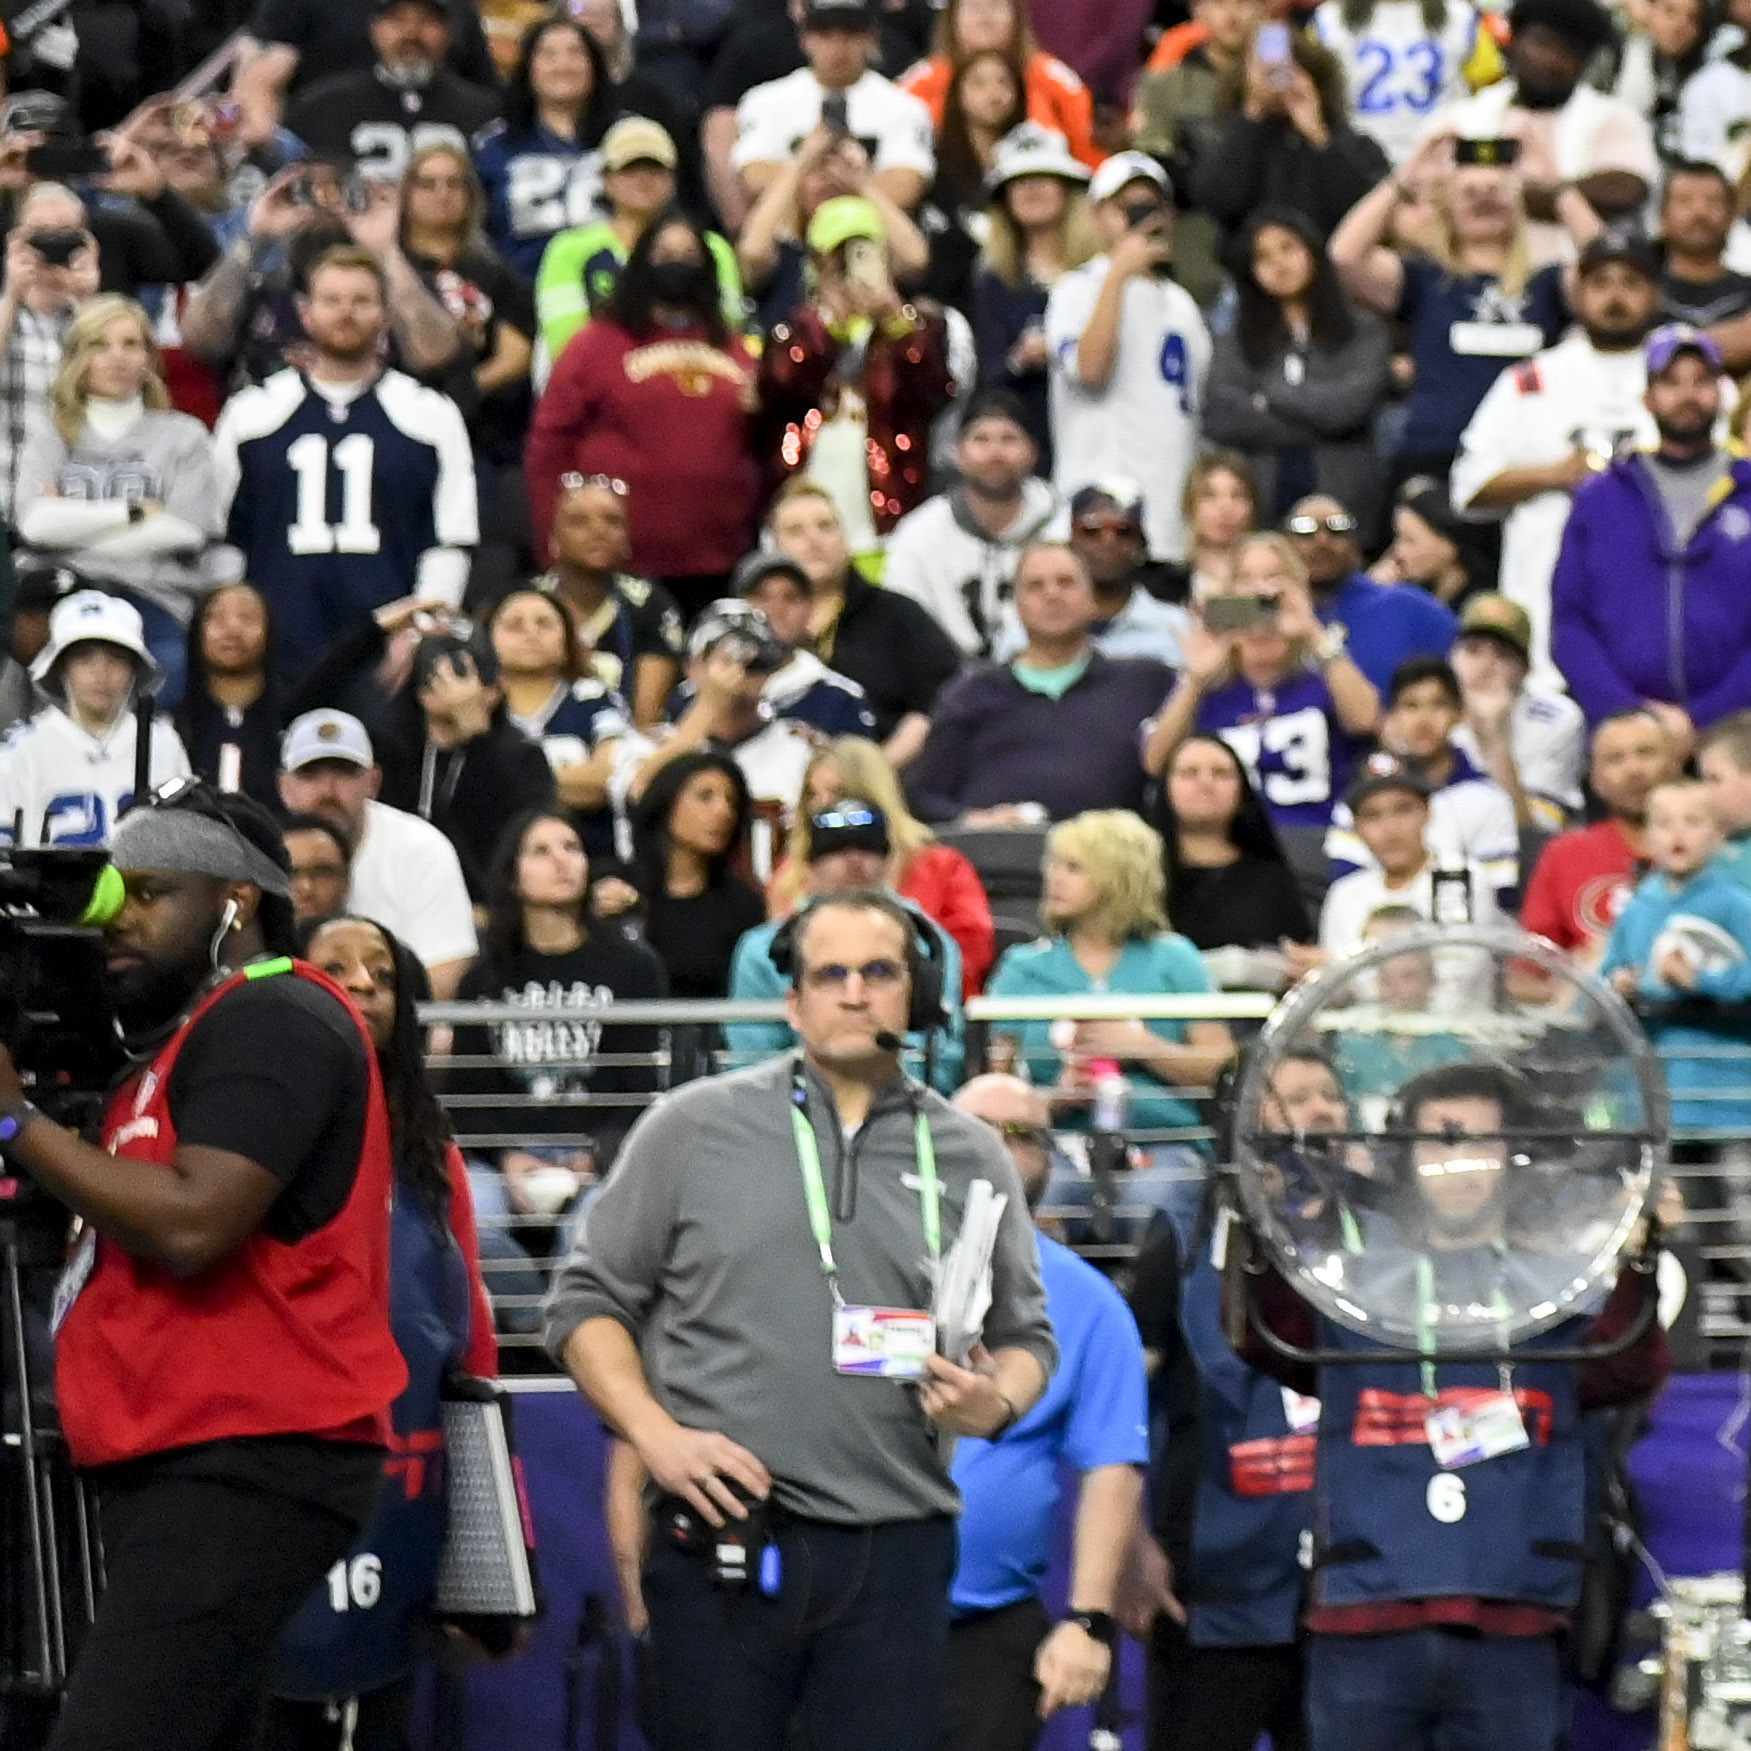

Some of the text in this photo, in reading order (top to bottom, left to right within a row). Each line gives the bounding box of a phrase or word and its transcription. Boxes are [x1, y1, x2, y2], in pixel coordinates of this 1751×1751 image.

[1355, 38, 1446, 115] 23
[287, 433, 380, 554] 11
[1426, 1472, 1467, 1523] 6
[326, 1552, 382, 1613] 16
